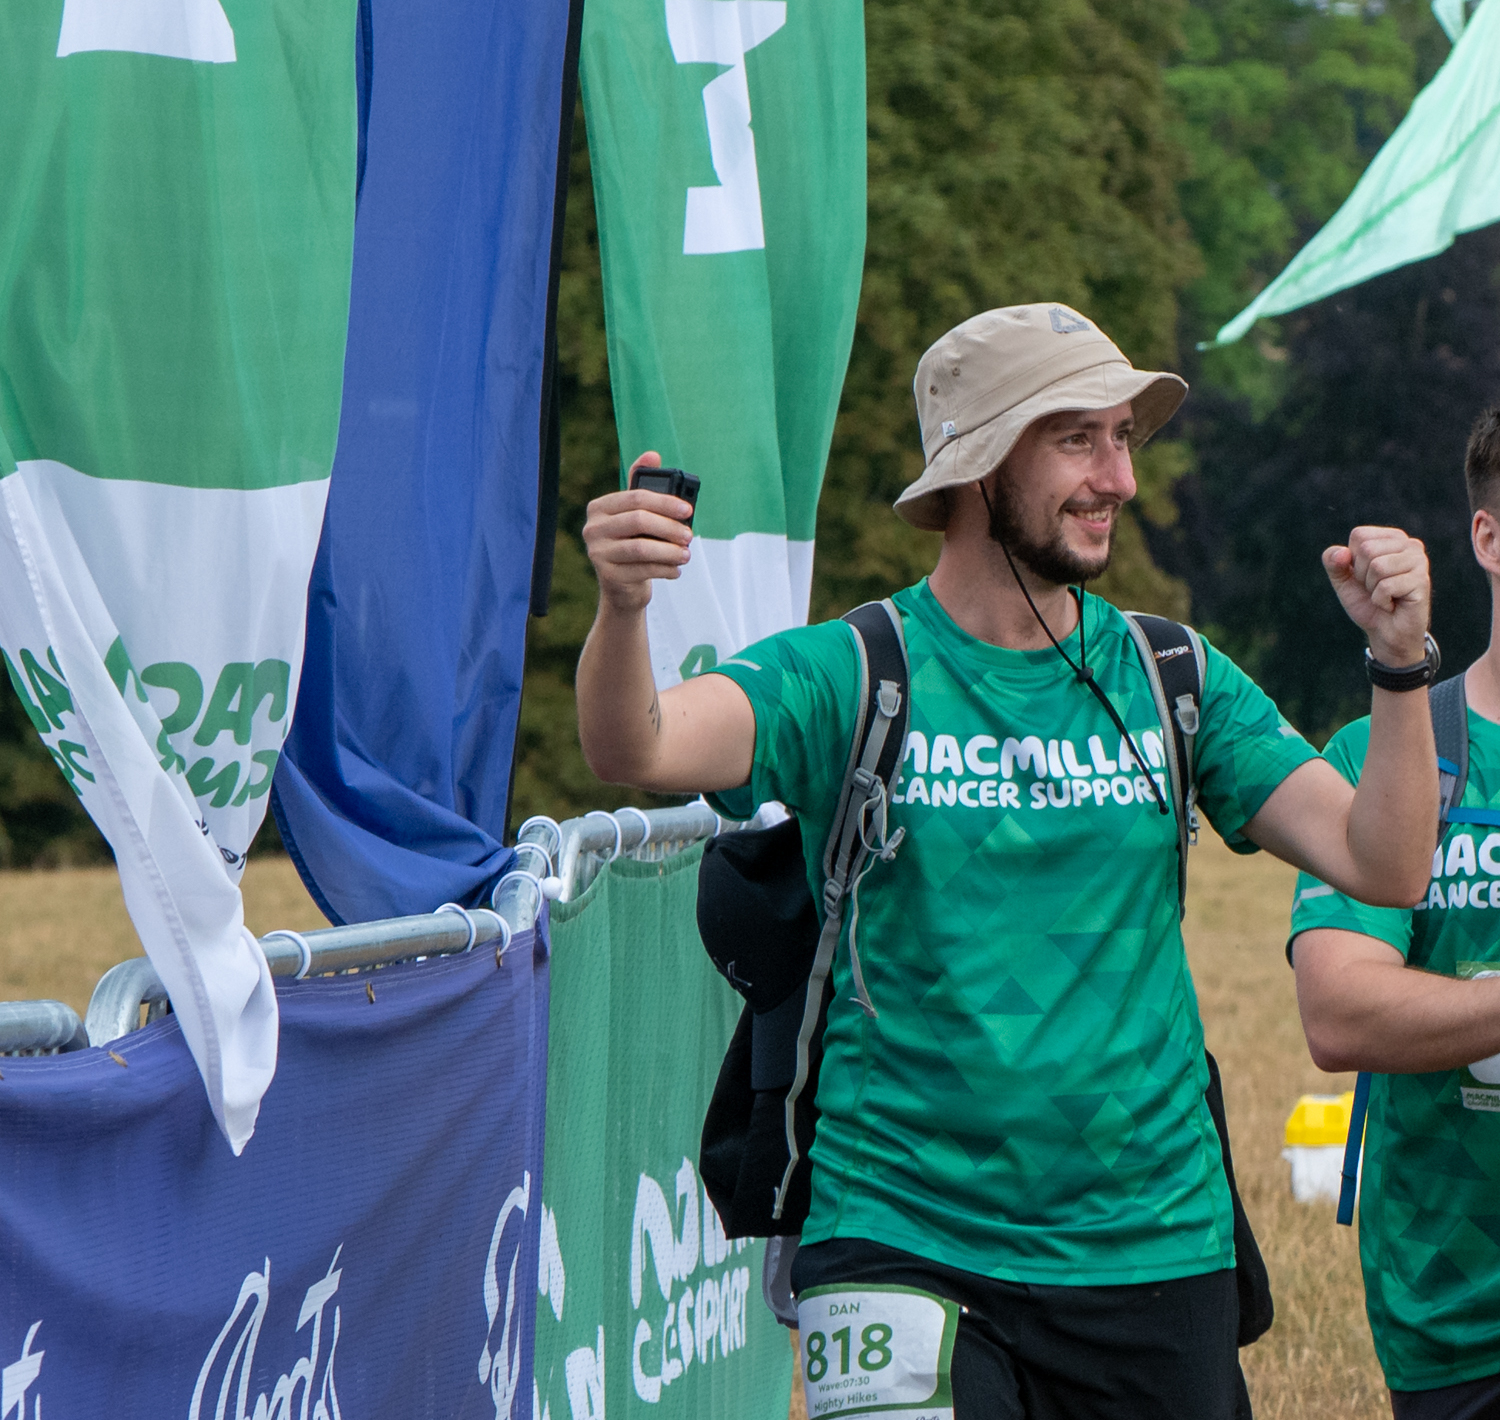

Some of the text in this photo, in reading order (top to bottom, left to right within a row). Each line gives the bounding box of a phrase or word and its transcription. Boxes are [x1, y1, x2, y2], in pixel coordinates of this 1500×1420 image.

[1158, 645, 1189, 658] Vango
[829, 1302, 860, 1316] DAN
[806, 1323, 893, 1383] 818
[818, 1376, 870, 1393] Wave:07:30
[814, 1392, 878, 1413] Mighty Hikes
